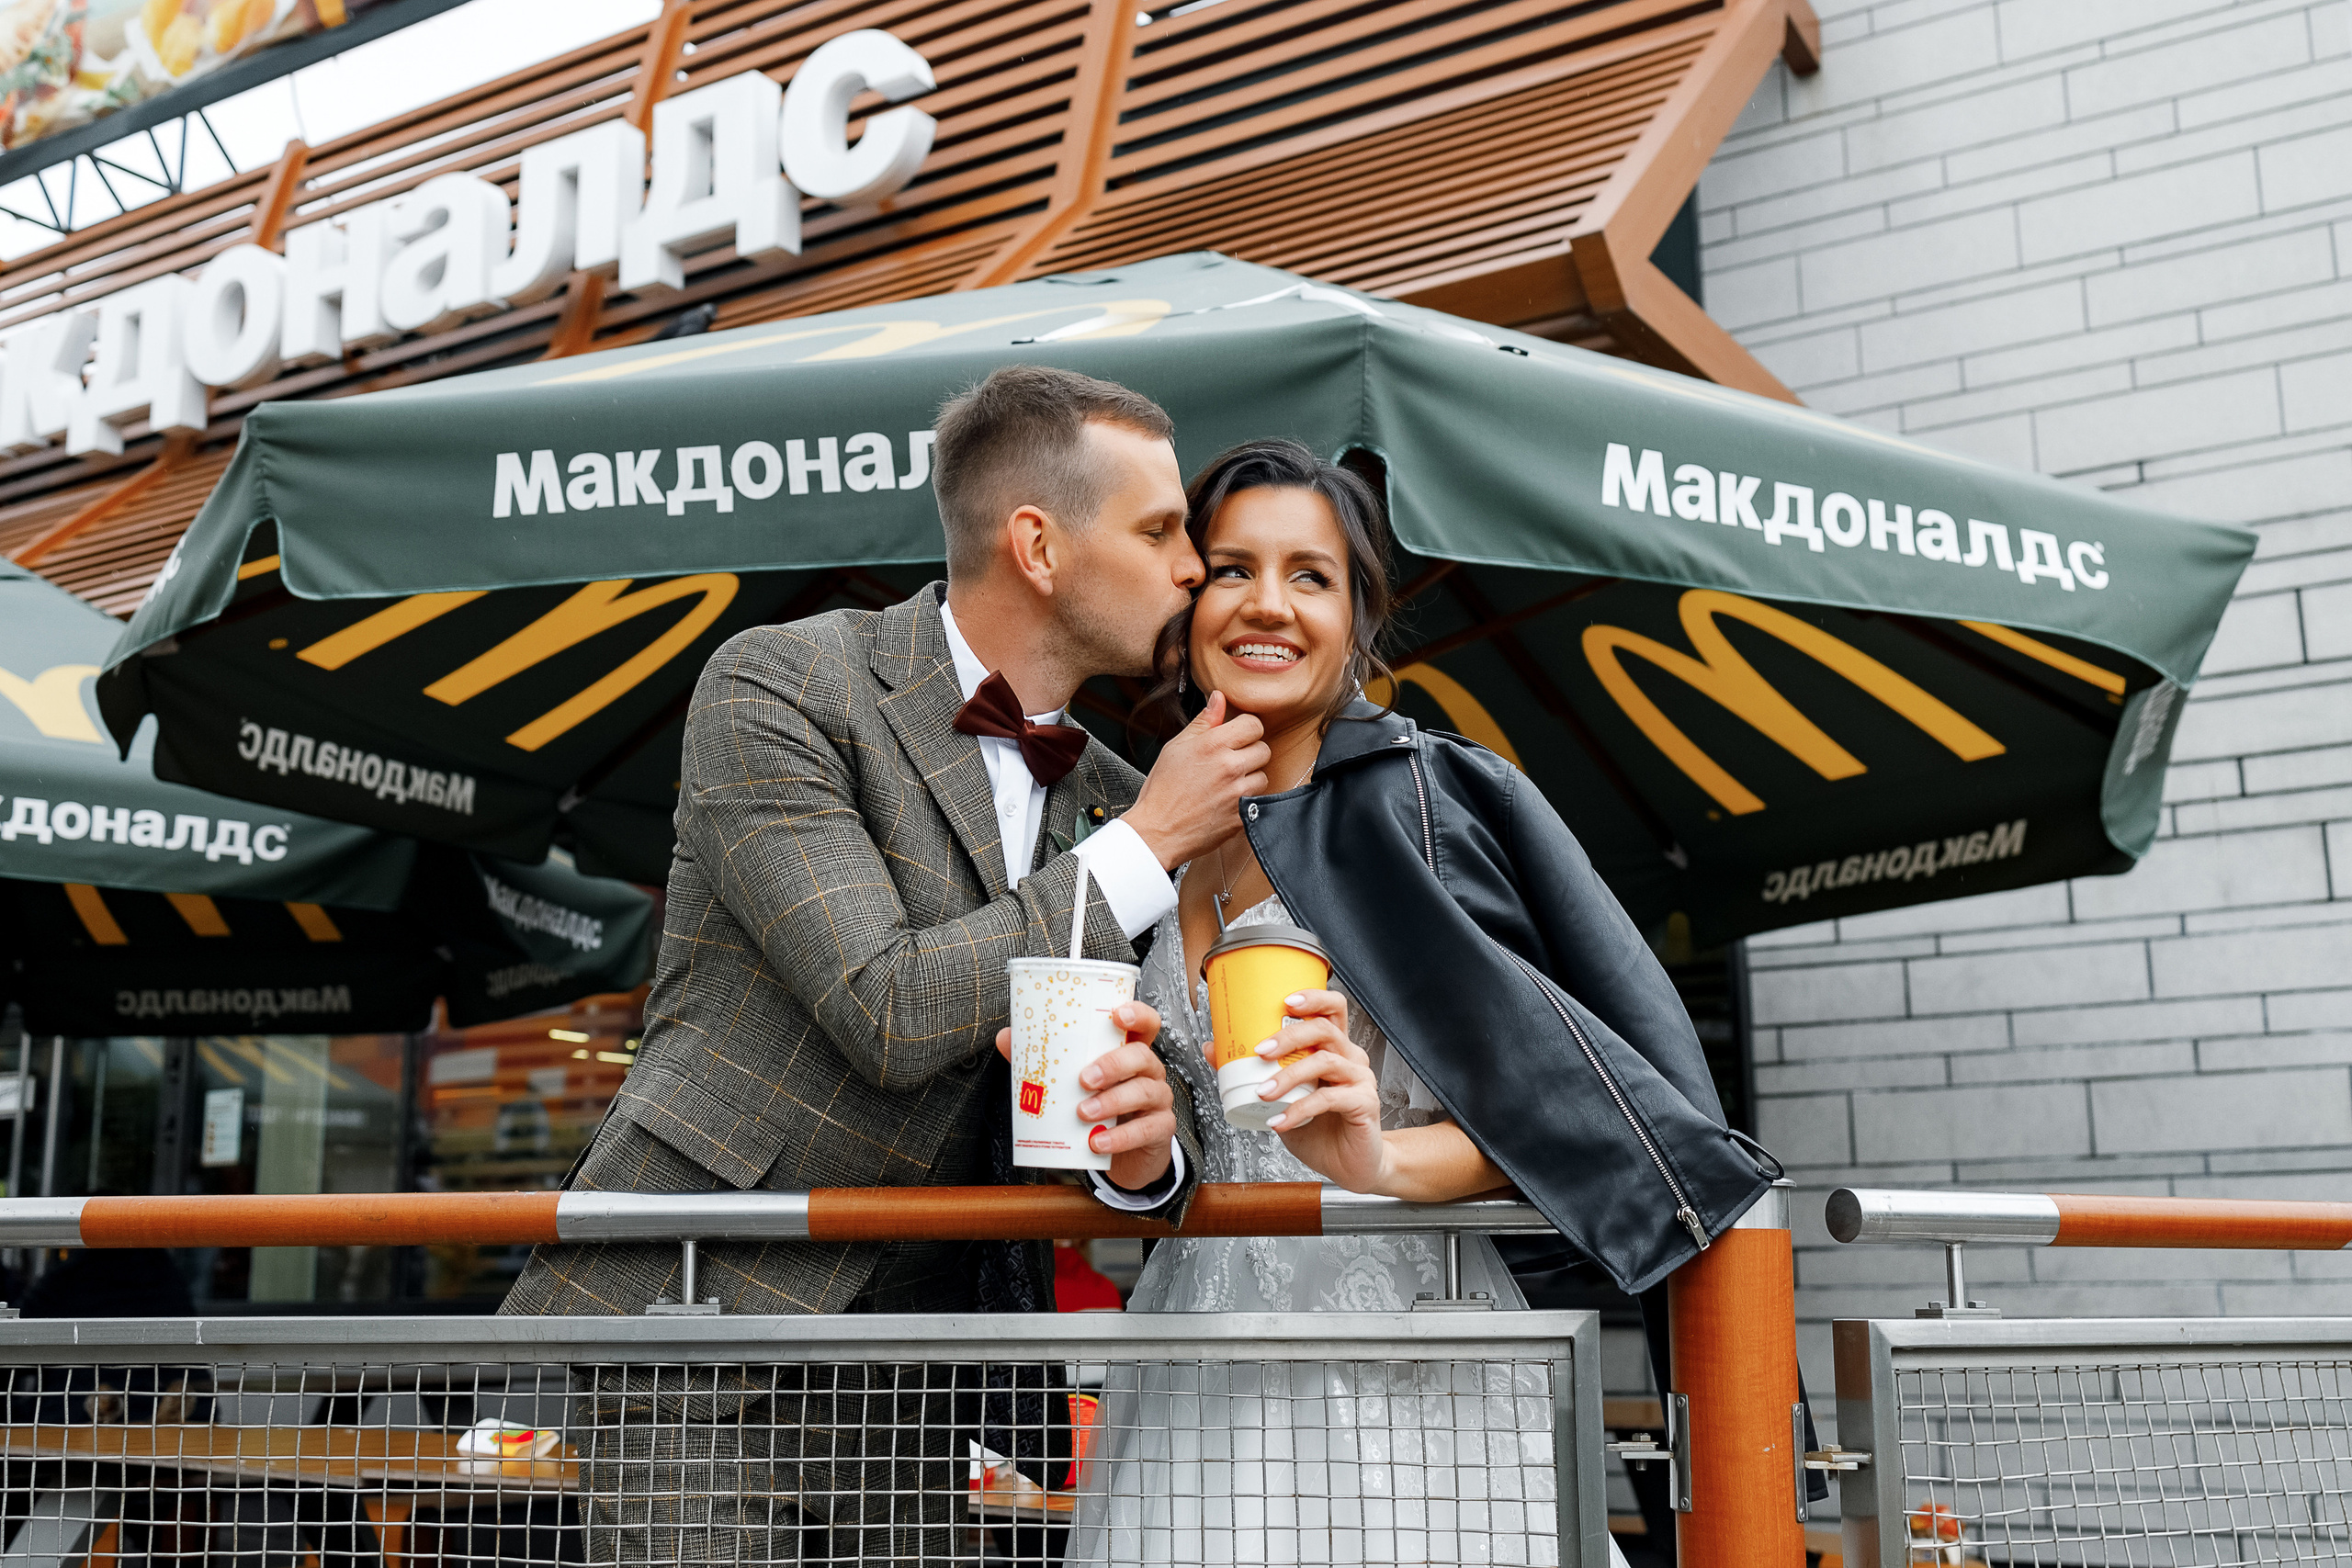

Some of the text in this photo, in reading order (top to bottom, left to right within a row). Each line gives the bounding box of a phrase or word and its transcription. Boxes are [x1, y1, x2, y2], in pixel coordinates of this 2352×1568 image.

[492, 430, 937, 518] Макдонал
[1601, 442, 2109, 592] Макдоналдс
[0, 795, 288, 865] доналдс
